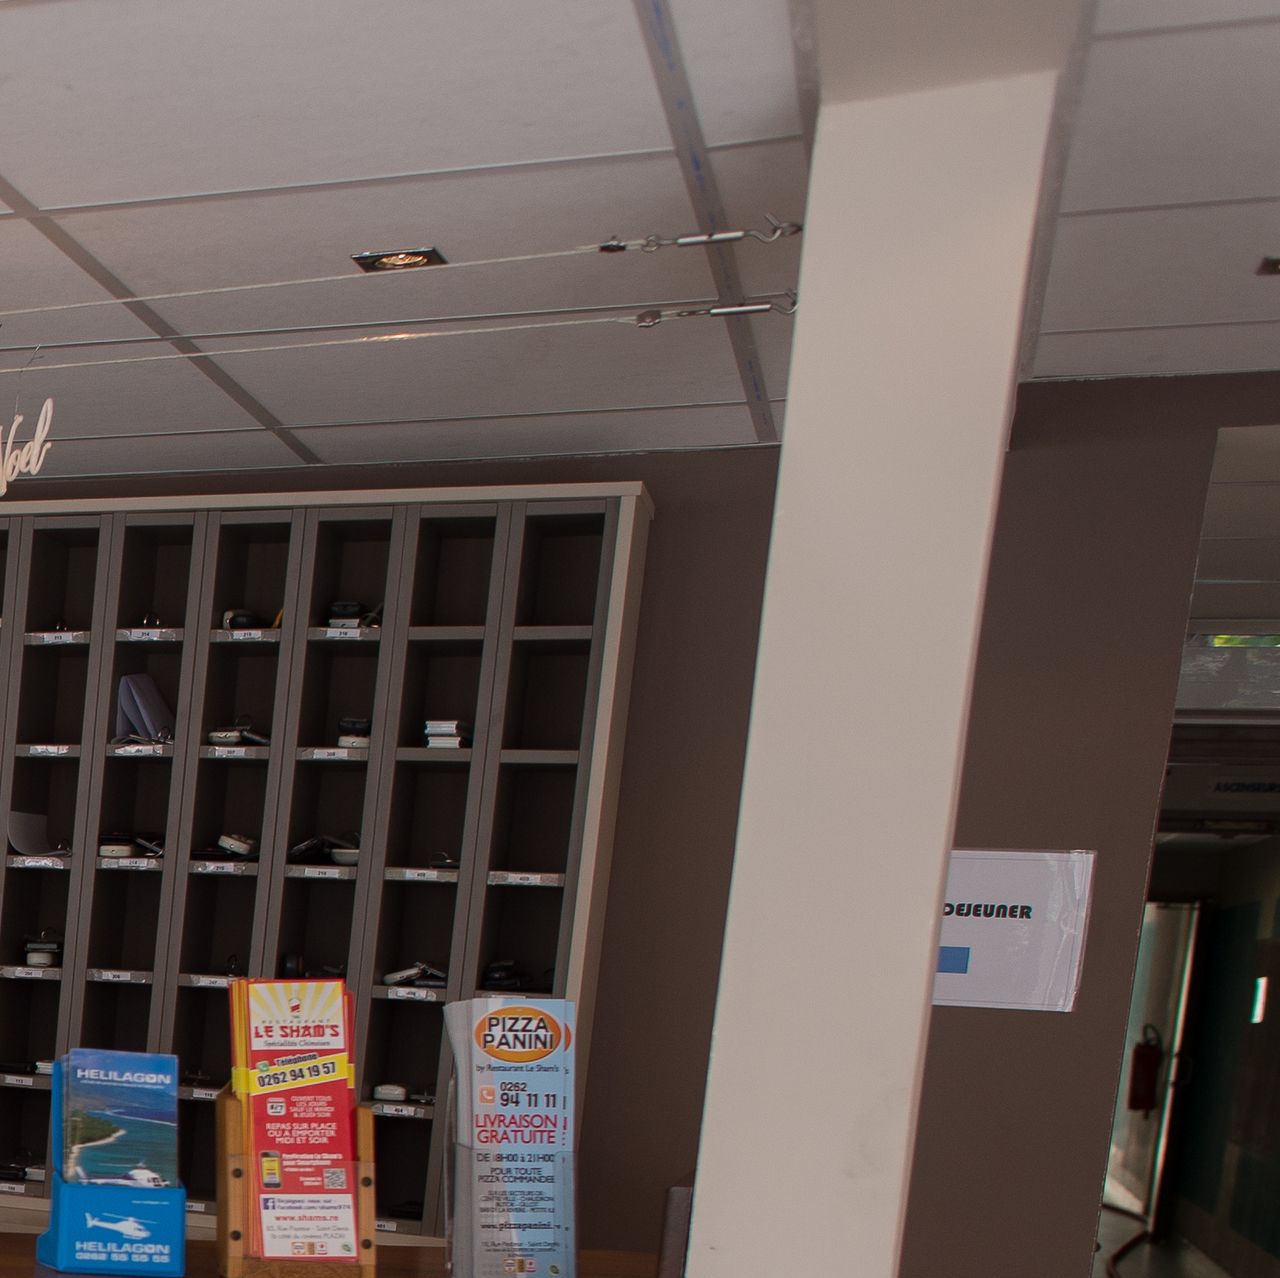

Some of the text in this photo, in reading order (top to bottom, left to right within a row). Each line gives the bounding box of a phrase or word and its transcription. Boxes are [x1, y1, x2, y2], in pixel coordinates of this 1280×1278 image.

[254, 1025, 273, 1038] LE
[488, 1016, 549, 1033] PIZZA
[483, 1033, 553, 1049] PANINI
[77, 1068, 171, 1084] HELILAGON
[258, 1062, 336, 1088] 0262 94 19 57
[476, 1064, 559, 1073] by Restaurant Le Sham's
[500, 1082, 527, 1092] 0262
[500, 1093, 557, 1108] 94 11 11
[266, 1122, 291, 1130] REPAS
[475, 1114, 558, 1129] LIVRAISON
[477, 1129, 556, 1144] GRATUITE
[477, 1153, 489, 1162] DE
[527, 1153, 555, 1163] 21H00
[490, 1167, 543, 1176] POUR TOUTE
[478, 1175, 500, 1184] PIZZA
[75, 1240, 171, 1255] HELILAGON
